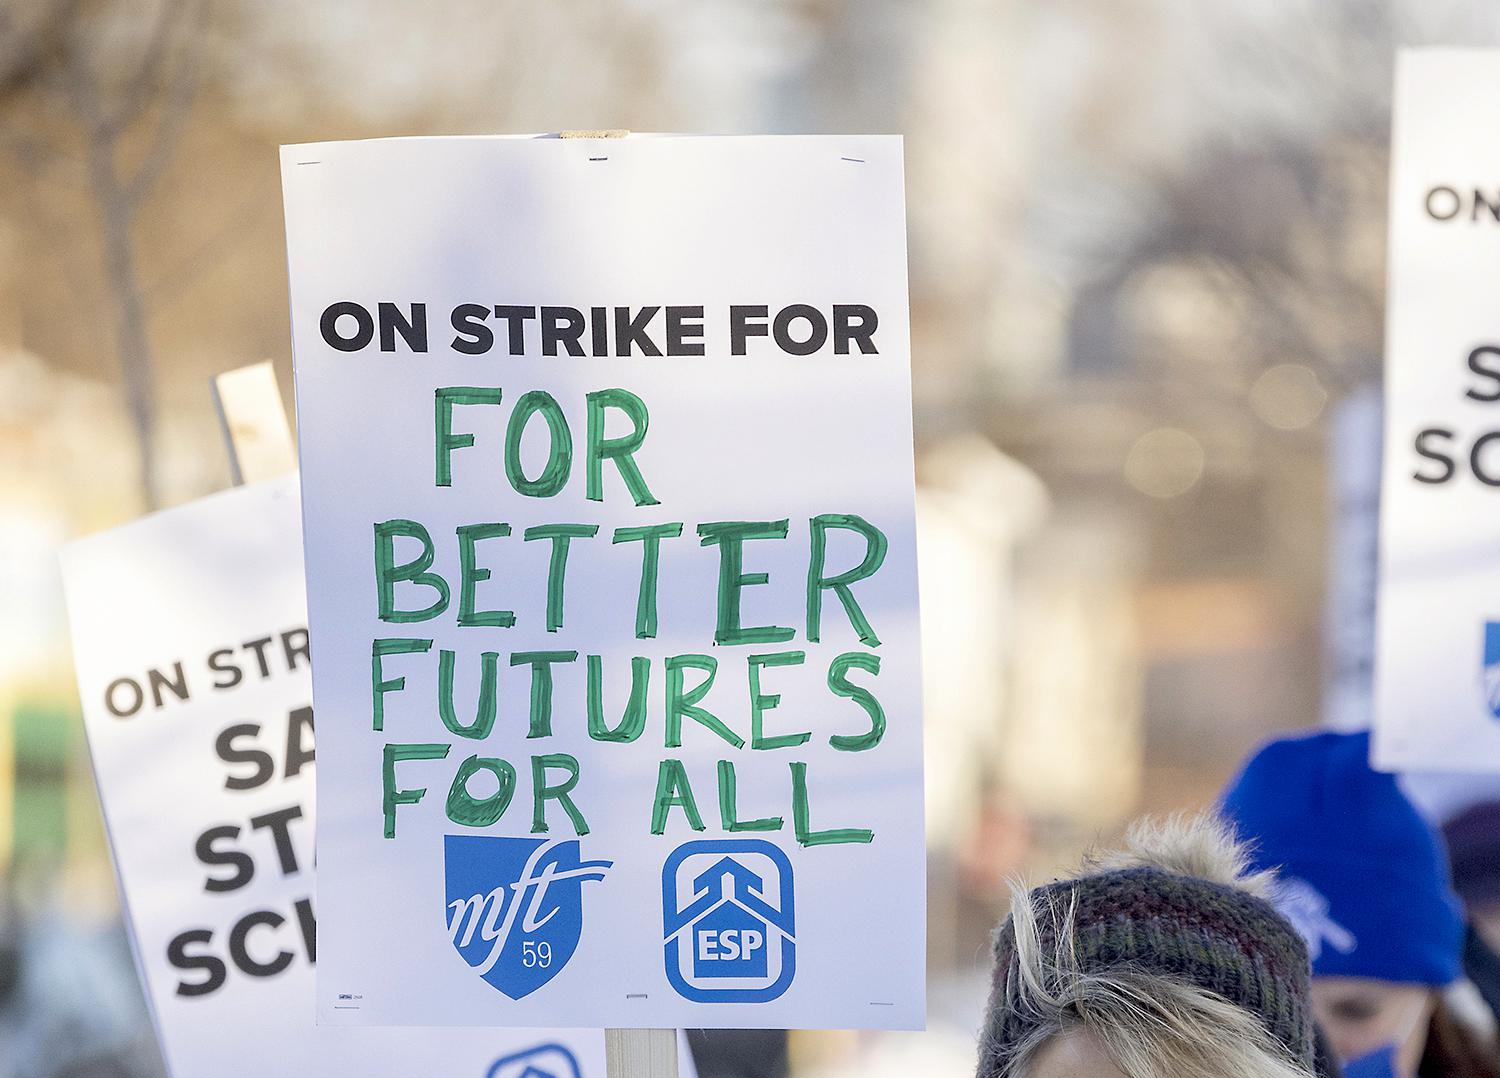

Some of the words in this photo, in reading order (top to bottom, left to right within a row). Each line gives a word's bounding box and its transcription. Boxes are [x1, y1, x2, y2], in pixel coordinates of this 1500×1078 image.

[319, 302, 428, 353] ON
[450, 303, 706, 357] STRIKE
[729, 304, 880, 355] FOR
[434, 386, 661, 506] FOR
[372, 513, 889, 646] BETTER
[105, 661, 189, 717] ON
[371, 638, 887, 752] FUTURES
[382, 743, 588, 839] FOR
[650, 758, 874, 846] ALL
[195, 805, 317, 892] ST
[447, 836, 613, 976] mft
[699, 929, 764, 961] ESP
[522, 941, 552, 969] 59
